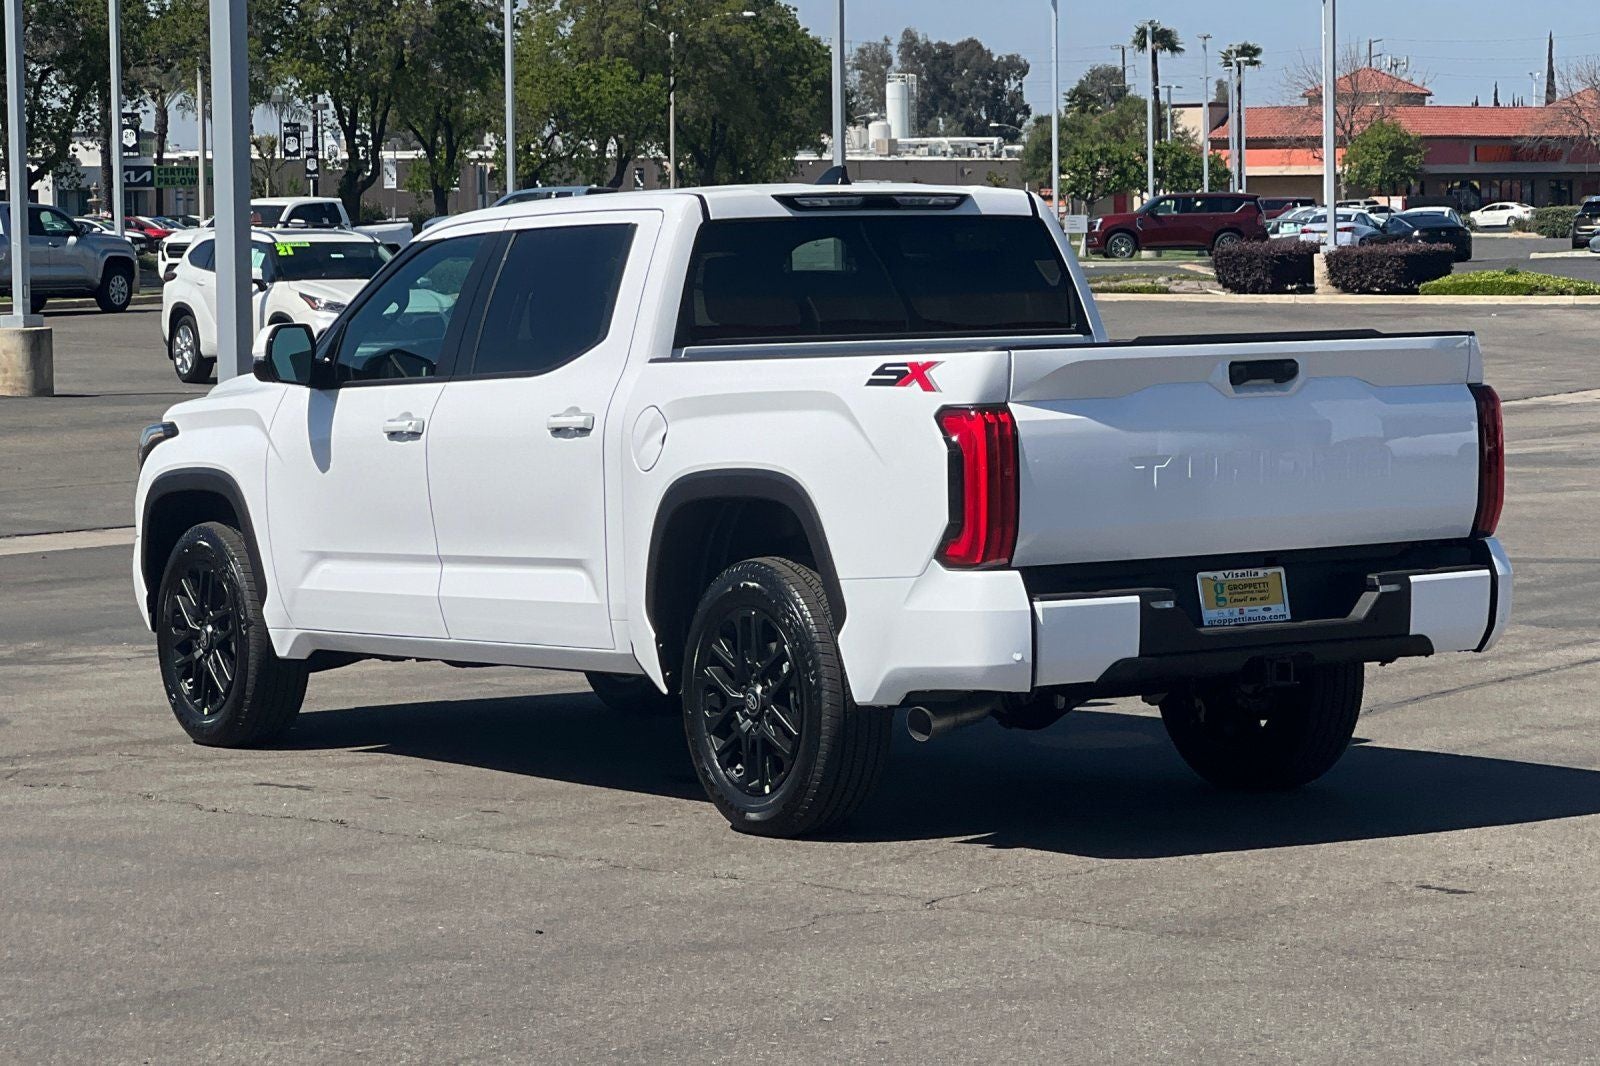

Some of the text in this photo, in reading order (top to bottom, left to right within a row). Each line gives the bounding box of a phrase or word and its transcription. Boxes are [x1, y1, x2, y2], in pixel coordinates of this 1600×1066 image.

[277, 246, 294, 256] 21
[864, 361, 945, 392] SX
[1222, 570, 1259, 579] Visalia
[1227, 582, 1269, 591] GROPPETTI
[1207, 613, 1287, 627] groppettiauto.com
